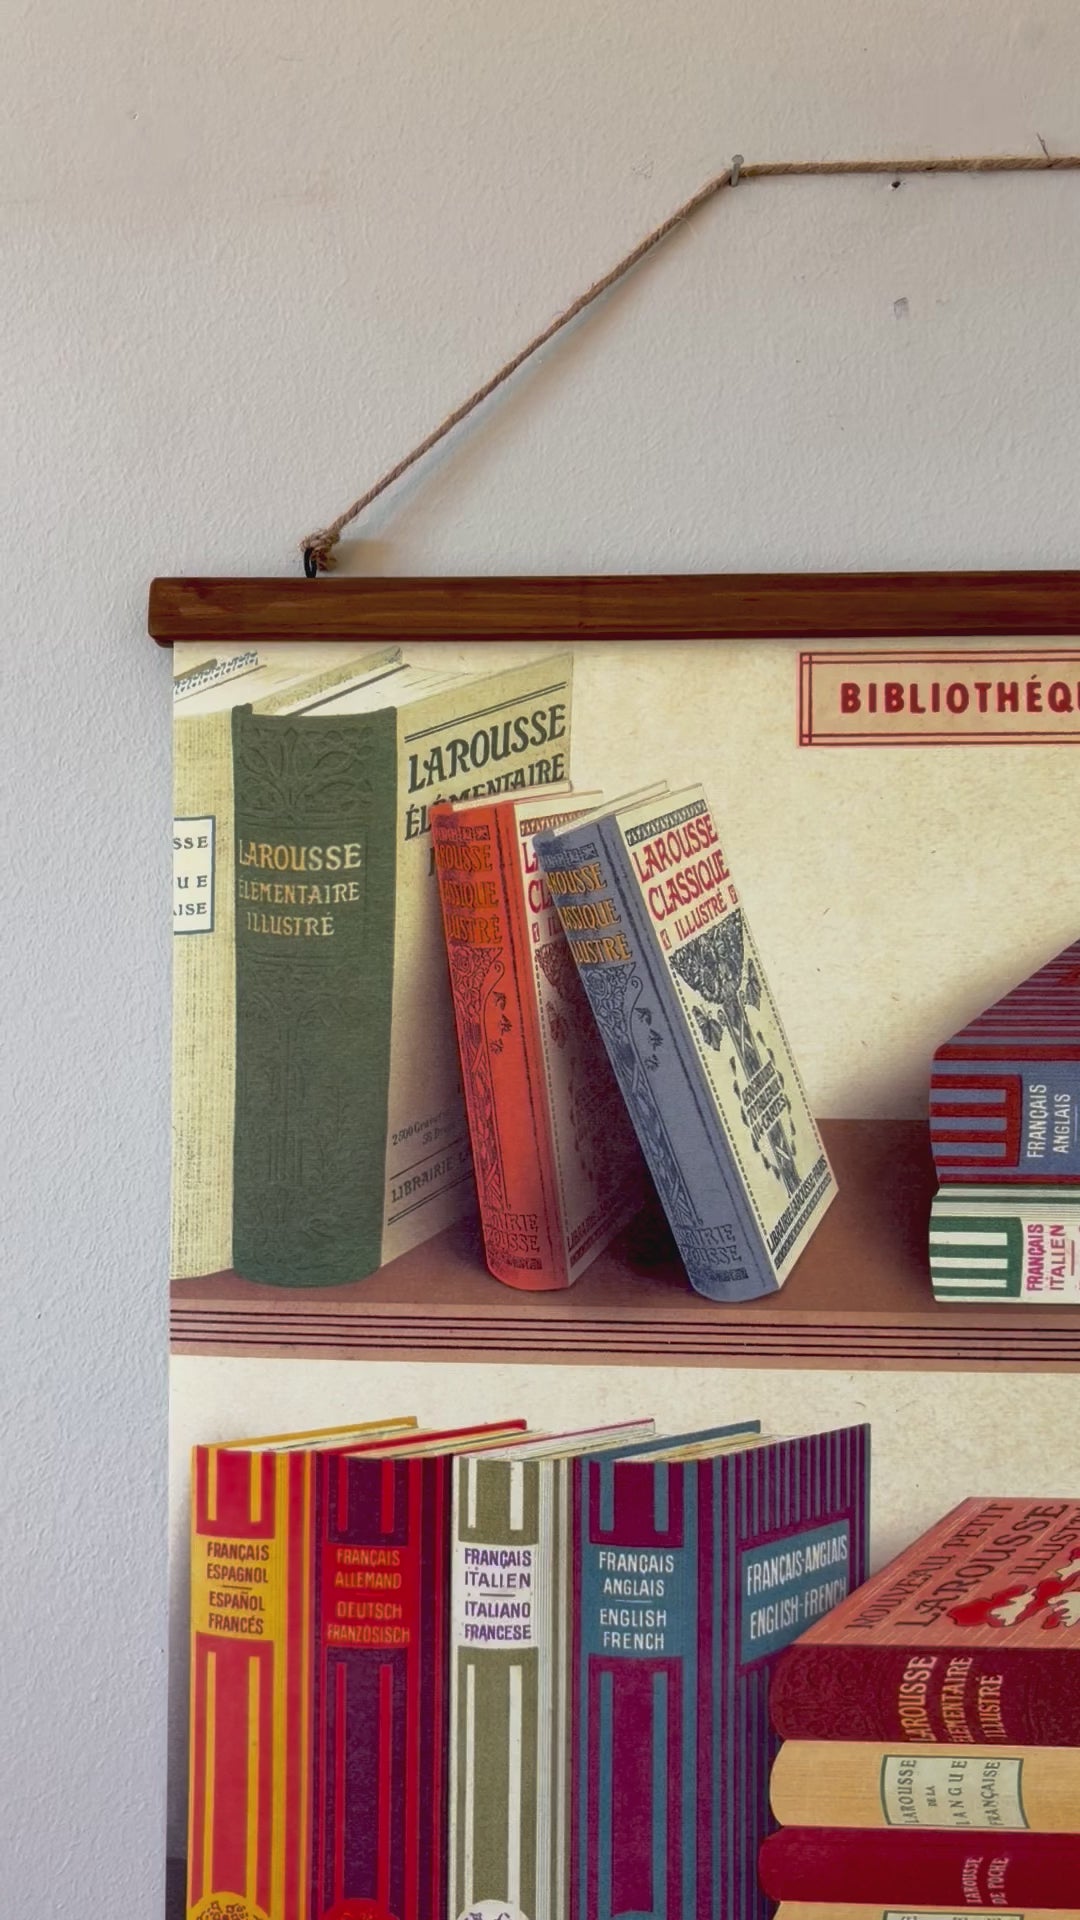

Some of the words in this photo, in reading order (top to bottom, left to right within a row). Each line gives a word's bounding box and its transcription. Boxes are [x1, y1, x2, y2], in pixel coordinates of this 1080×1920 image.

[840, 674, 1080, 713] BIBLIOTHÉQ
[408, 704, 566, 794] LAROUSSE
[239, 840, 361, 871] LAROUSSE
[632, 813, 719, 884] LAROUSSE
[649, 849, 730, 921] CLASSIQUE
[173, 902, 208, 916] ISE
[247, 911, 335, 936] ILLUSTRÉ
[674, 887, 728, 942] ILLUSTRÉ
[1027, 1084, 1049, 1158] FRANÇAIS
[1052, 1093, 1071, 1154] ANGLAIS
[391, 1156, 455, 1203] LIBRAIRIE
[1026, 1224, 1047, 1291] FRANÇAIS
[1049, 1225, 1066, 1291] ITALIEN
[207, 1542, 270, 1563] FRANÇAIS
[336, 1548, 401, 1568] FRANÇAIS
[464, 1547, 532, 1570] FRANÇAIS
[599, 1551, 675, 1575] FRANÇAIS
[844, 1554, 957, 1629] NOUVEAU
[942, 1503, 1013, 1549] PETIT
[894, 1504, 1069, 1627] LAROUSSE
[206, 1563, 269, 1584] ESPAGNOL
[334, 1571, 403, 1591] ALLEMAND
[464, 1570, 532, 1589] ITALIEN
[603, 1577, 665, 1597] ANGLAIS
[209, 1591, 267, 1612] ESPAÑOL
[464, 1600, 531, 1619] ITALIANO
[599, 1608, 667, 1628] ENGLISH
[208, 1612, 265, 1636] FRANCÉS
[464, 1623, 532, 1642] FRANCESE
[603, 1631, 665, 1651] FRENCH
[898, 1655, 938, 1743] LAROUSSE
[975, 1673, 1008, 1739] ILLUSTRÉ
[898, 1758, 919, 1824] LAROUSSE
[948, 1760, 971, 1826] LANGUE
[980, 1761, 1004, 1827] FRANÇAISE
[962, 1856, 984, 1904] LAROUSSE
